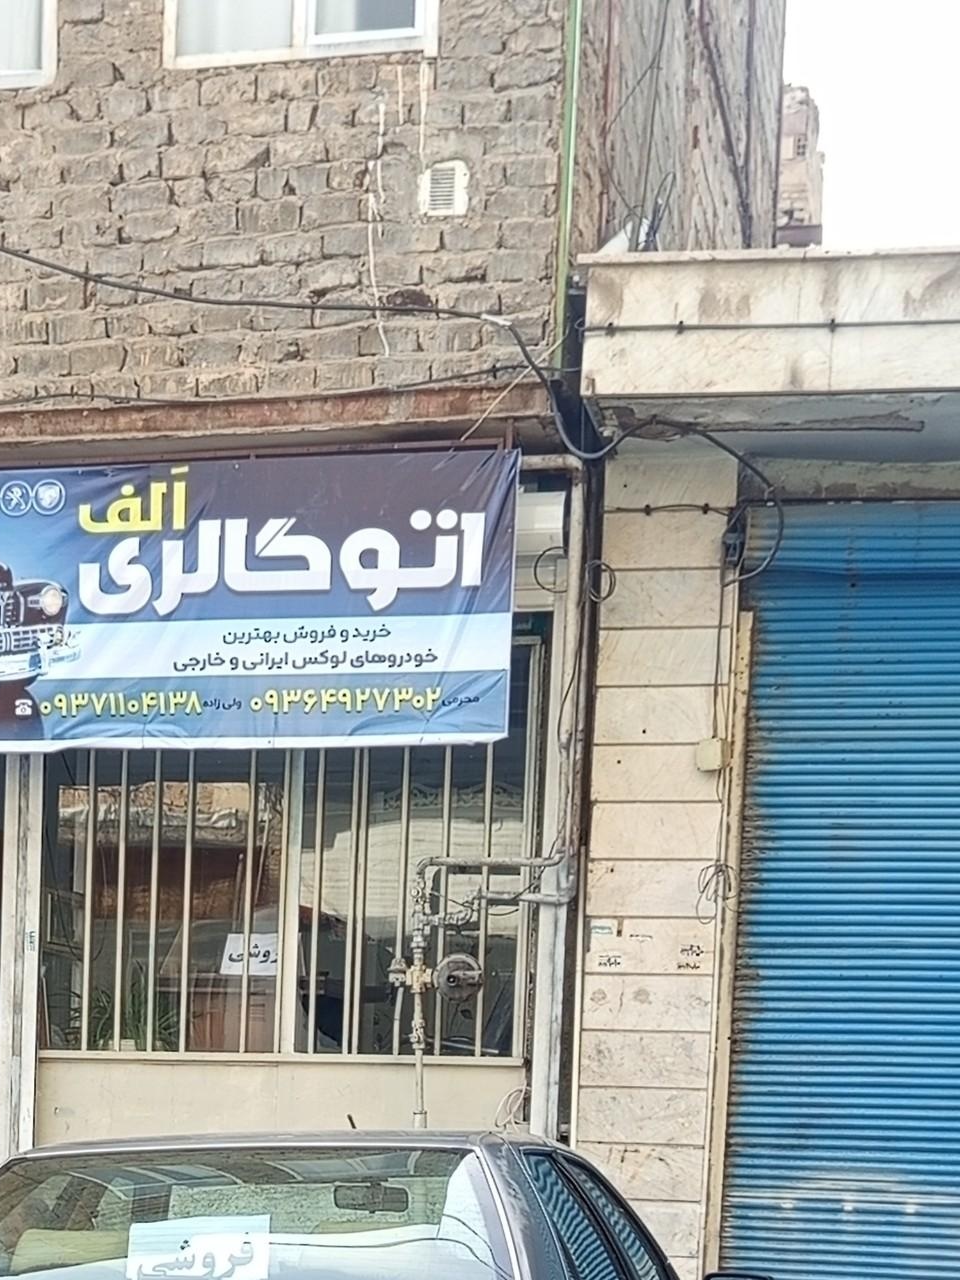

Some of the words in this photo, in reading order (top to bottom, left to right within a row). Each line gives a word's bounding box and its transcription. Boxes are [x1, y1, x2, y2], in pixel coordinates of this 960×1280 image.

[222, 627, 281, 645] بهترین
[283, 624, 337, 644] فروش
[339, 629, 350, 643] و
[352, 623, 392, 641] خرید
[173, 652, 226, 673] خارجی
[229, 655, 240, 670] و
[242, 651, 289, 671] ایرانی
[291, 650, 348, 670] لوکس
[349, 649, 439, 669] خودروهای
[40, 690, 203, 718] ۰۹۳۷۱۱۰۴۱۳۸
[249, 686, 442, 714] ۰۹۳۶۴۹۲۷۳۰۲
[138, 1231, 255, 1279] فروشی
